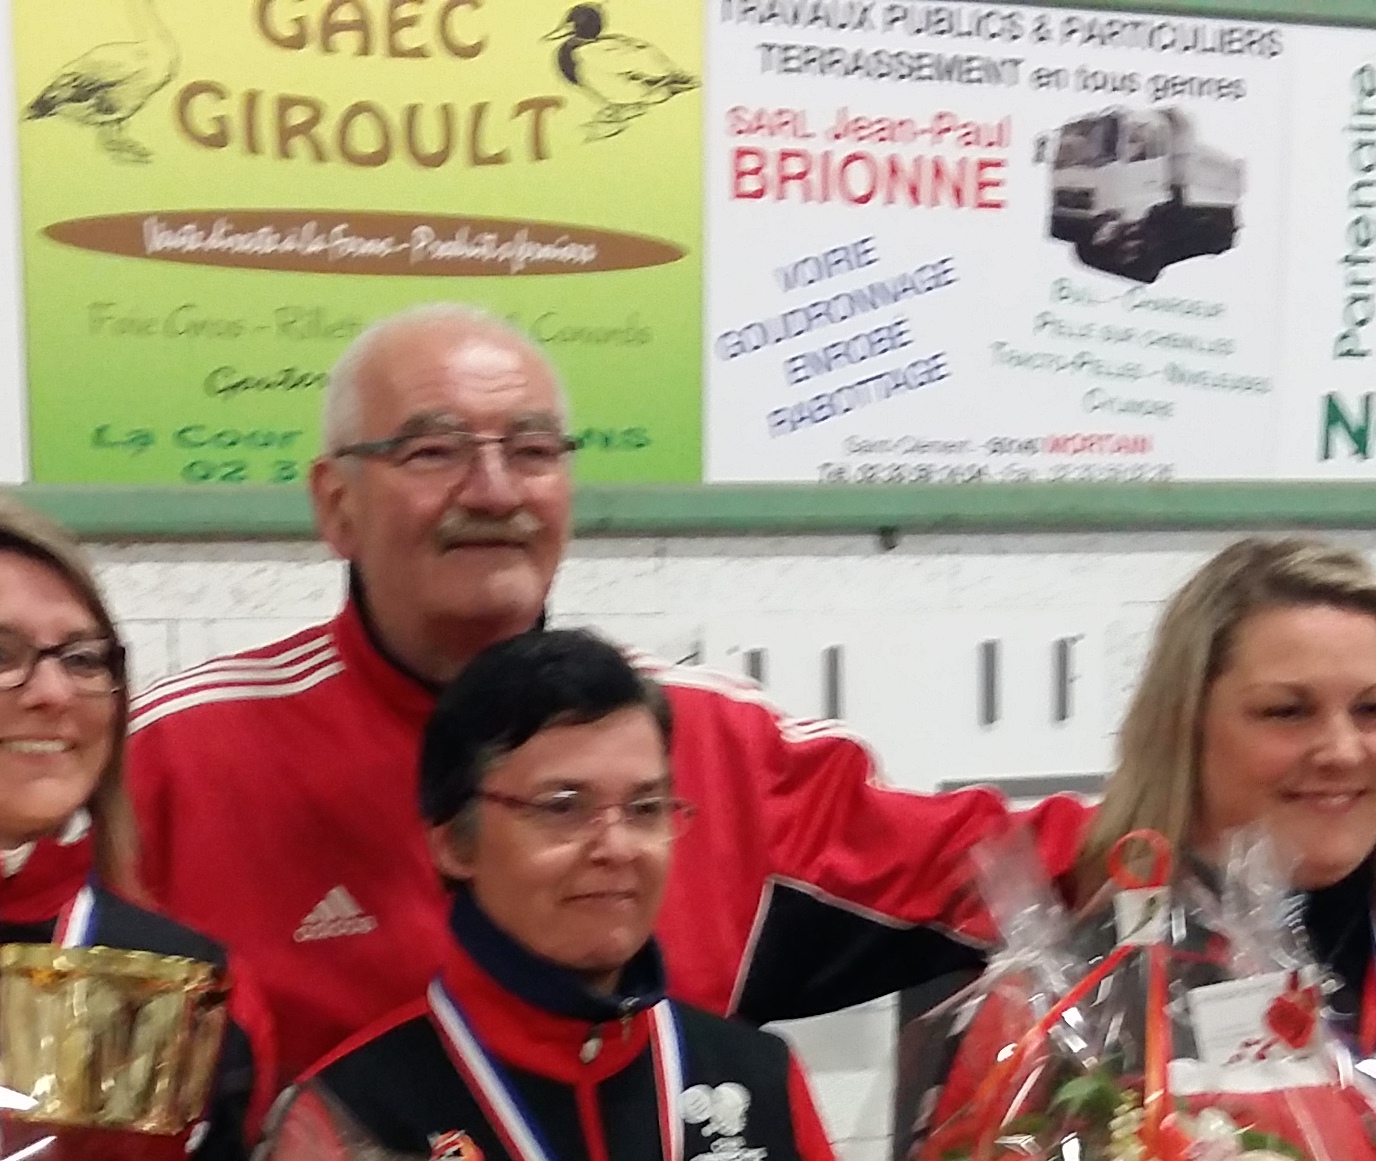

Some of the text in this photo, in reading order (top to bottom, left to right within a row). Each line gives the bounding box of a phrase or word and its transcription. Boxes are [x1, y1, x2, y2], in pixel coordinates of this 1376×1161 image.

[255, 0, 488, 60] GAEC
[720, 0, 875, 31] TRAVAUX
[881, 3, 1025, 41] PUBLICS
[1059, 15, 1284, 59] PARTICULIERS
[755, 41, 1248, 103] TERRASSEMENT en tous genres
[174, 79, 568, 169] GIROULT
[726, 105, 1013, 149] SARL Jean-Paul
[729, 146, 1010, 210] BRIONNE
[773, 235, 880, 293] VOIRIE
[714, 256, 960, 361] GOUDRONNAGE
[270, 459, 300, 483] 3
